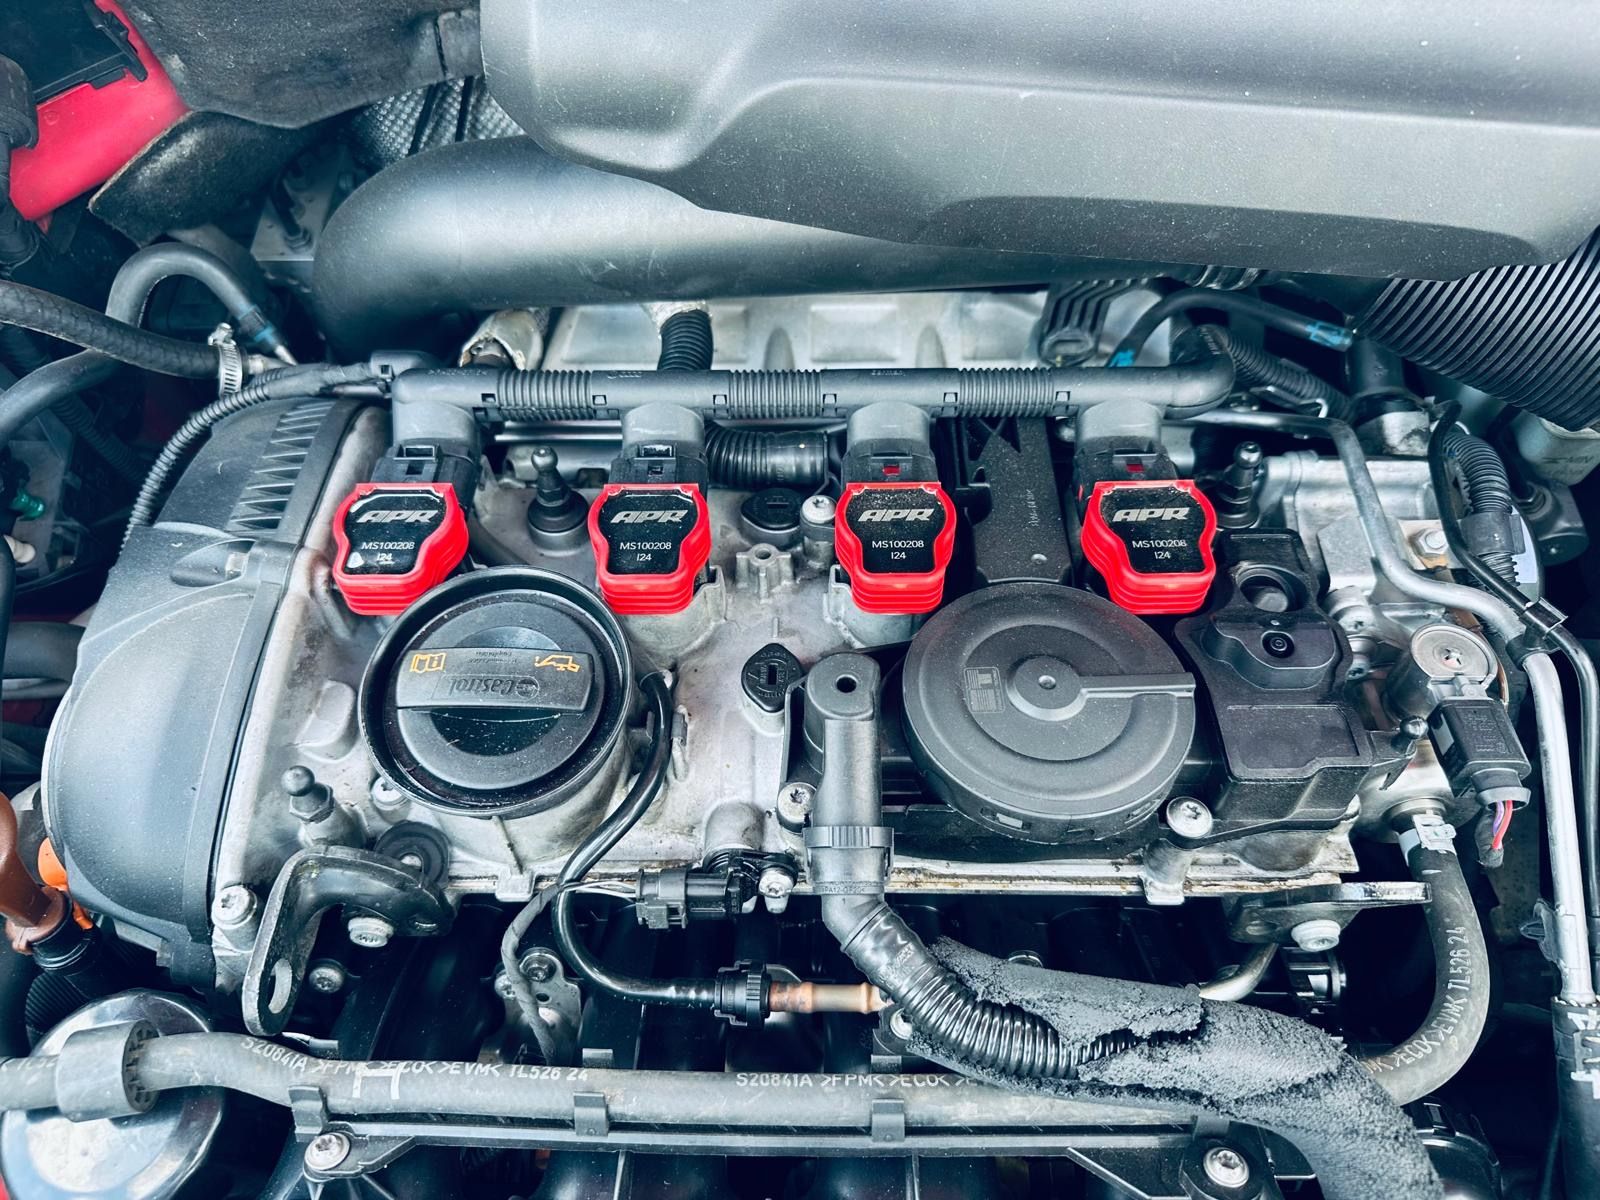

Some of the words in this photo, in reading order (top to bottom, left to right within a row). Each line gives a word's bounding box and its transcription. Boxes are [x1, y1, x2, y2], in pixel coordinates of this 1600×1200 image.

[356, 510, 440, 524] APR
[610, 509, 689, 524] APR
[858, 507, 935, 522] APR
[1112, 507, 1190, 522] APR
[361, 541, 415, 551] MS100208
[619, 541, 672, 551] MS100208
[871, 539, 925, 549] MS100208
[1132, 539, 1187, 549] MS100208
[447, 678, 516, 697] Castrol
[509, 1064, 561, 1081] TL526
[566, 1067, 588, 1082] 24
[736, 1072, 813, 1088] S20841A
